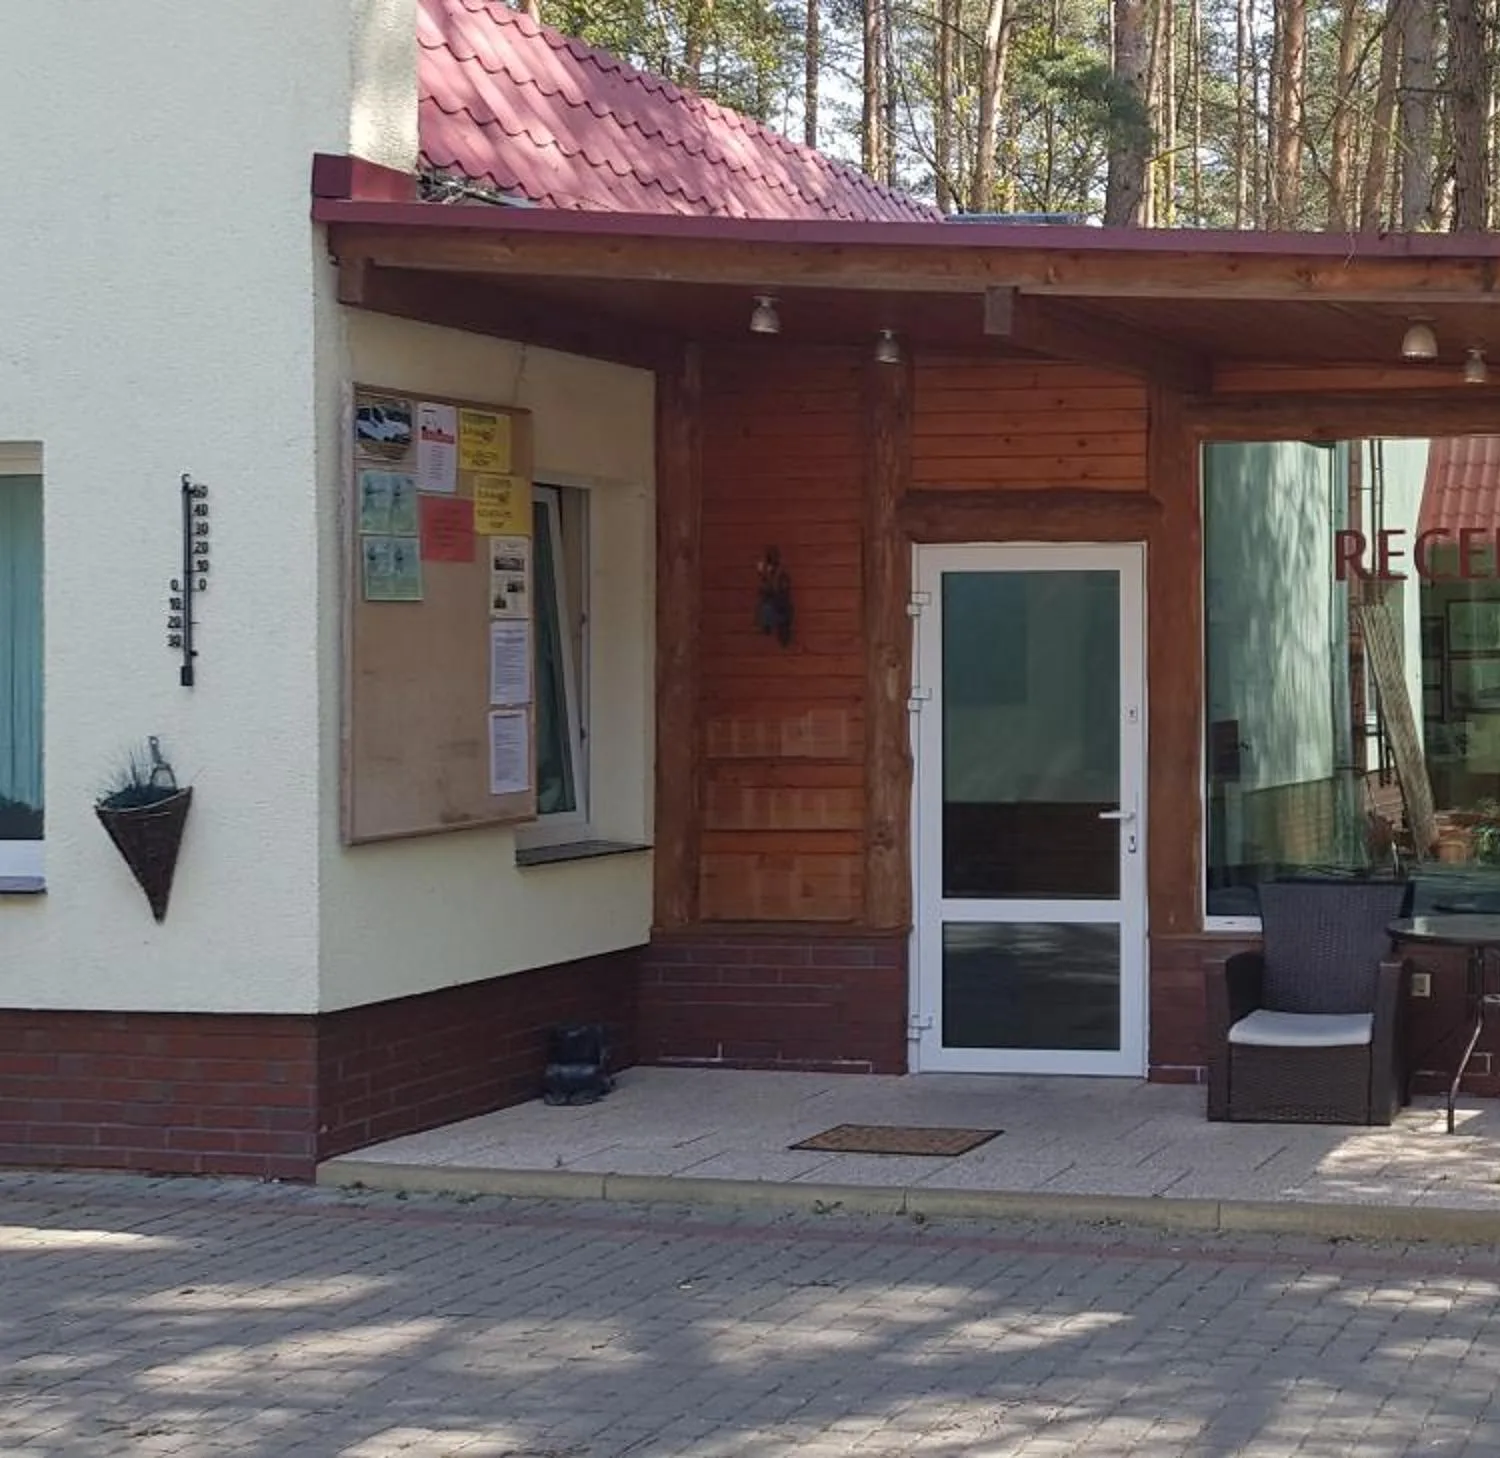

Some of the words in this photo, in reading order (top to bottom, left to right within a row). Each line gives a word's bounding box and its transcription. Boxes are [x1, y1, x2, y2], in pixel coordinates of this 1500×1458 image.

[194, 503, 208, 516] 40
[195, 522, 209, 535] 30
[195, 541, 209, 554] 20
[196, 559, 209, 572] 10
[170, 579, 179, 591] 0
[199, 578, 207, 591] 0
[169, 597, 181, 610] 10
[167, 616, 181, 628] 20
[167, 634, 181, 648] 30
